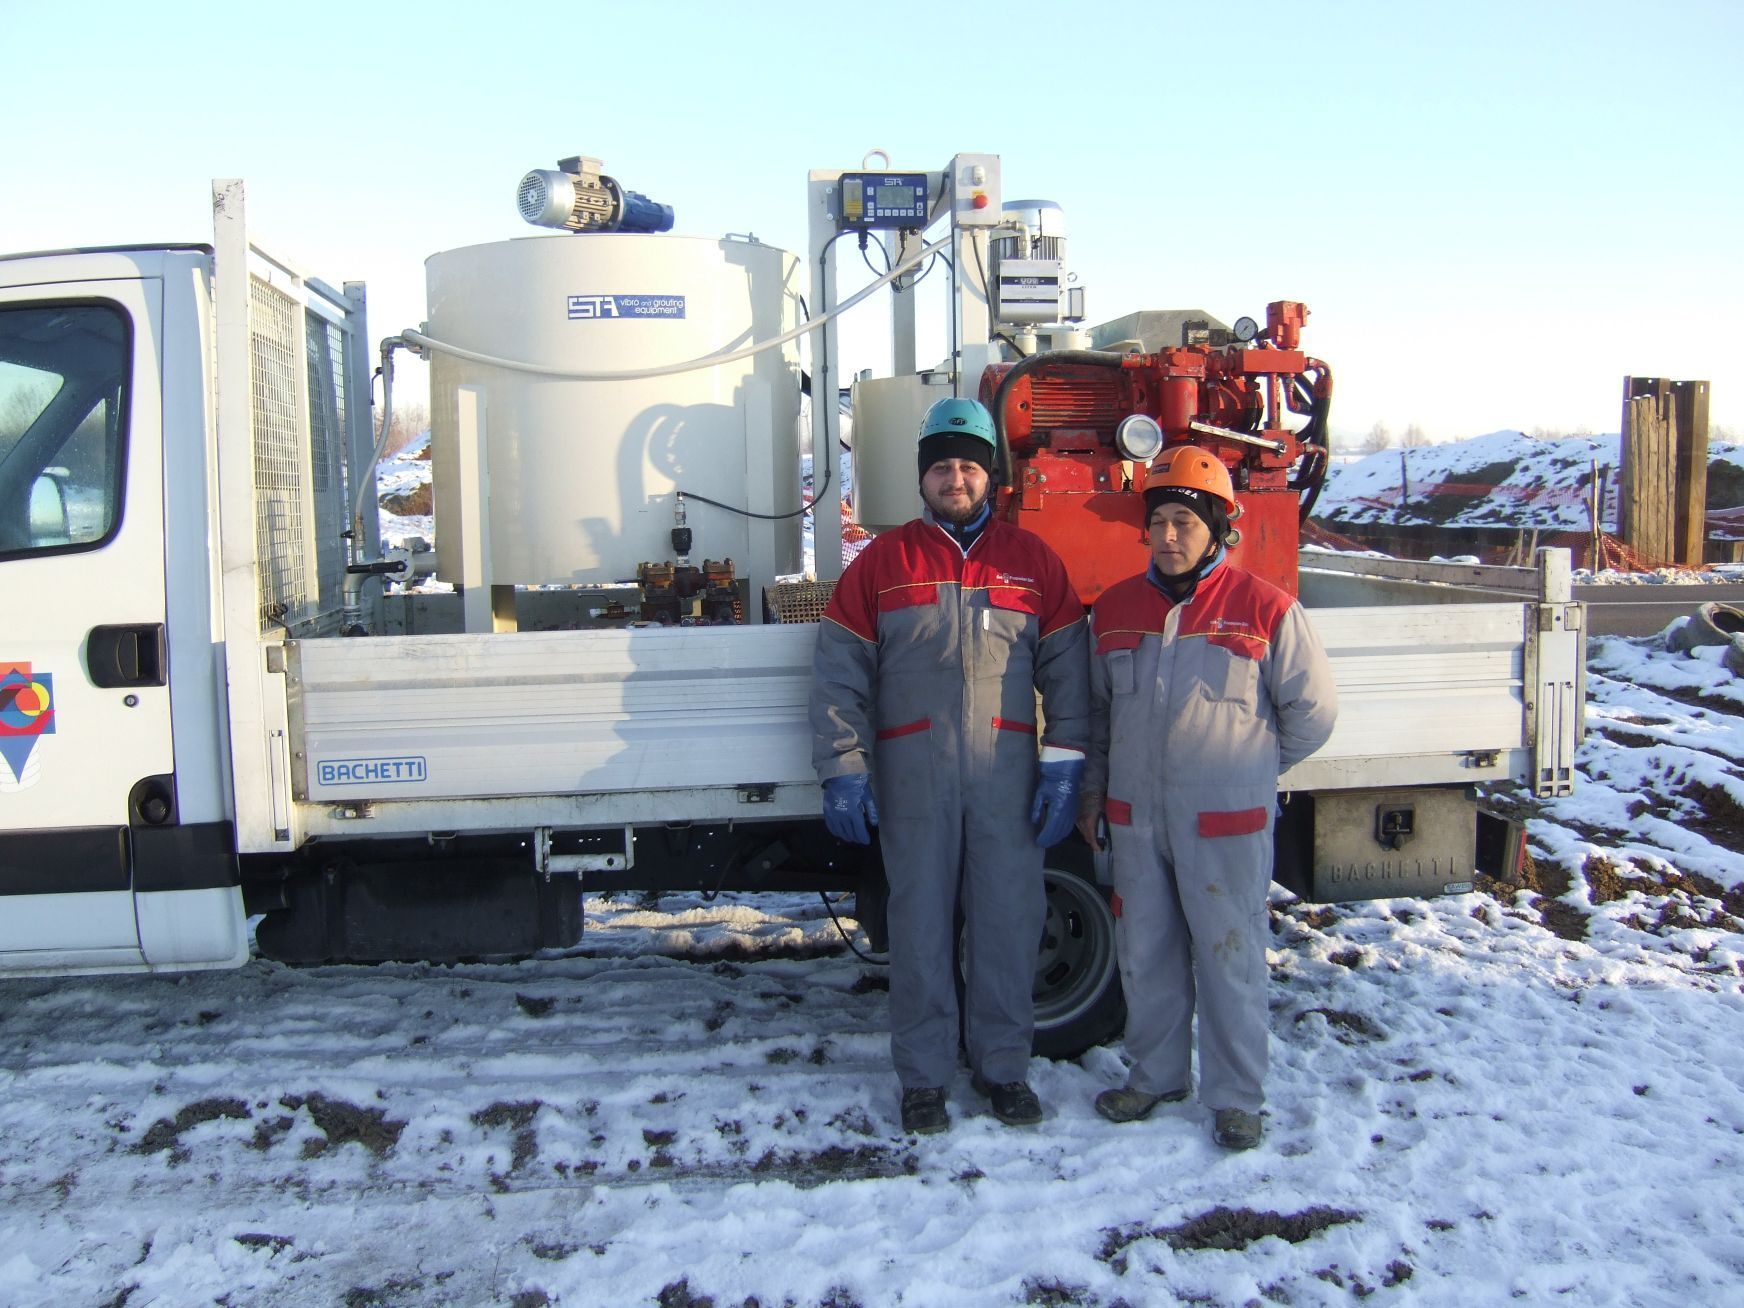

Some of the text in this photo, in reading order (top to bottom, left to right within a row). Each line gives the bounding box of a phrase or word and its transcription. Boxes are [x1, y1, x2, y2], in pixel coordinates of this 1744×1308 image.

[884, 178, 902, 186] STA
[569, 297, 619, 317] STA
[620, 299, 639, 307] vibro
[653, 299, 683, 308] grouting
[322, 762, 422, 781] BACHETTI
[1331, 857, 1456, 882] BACHETTI
